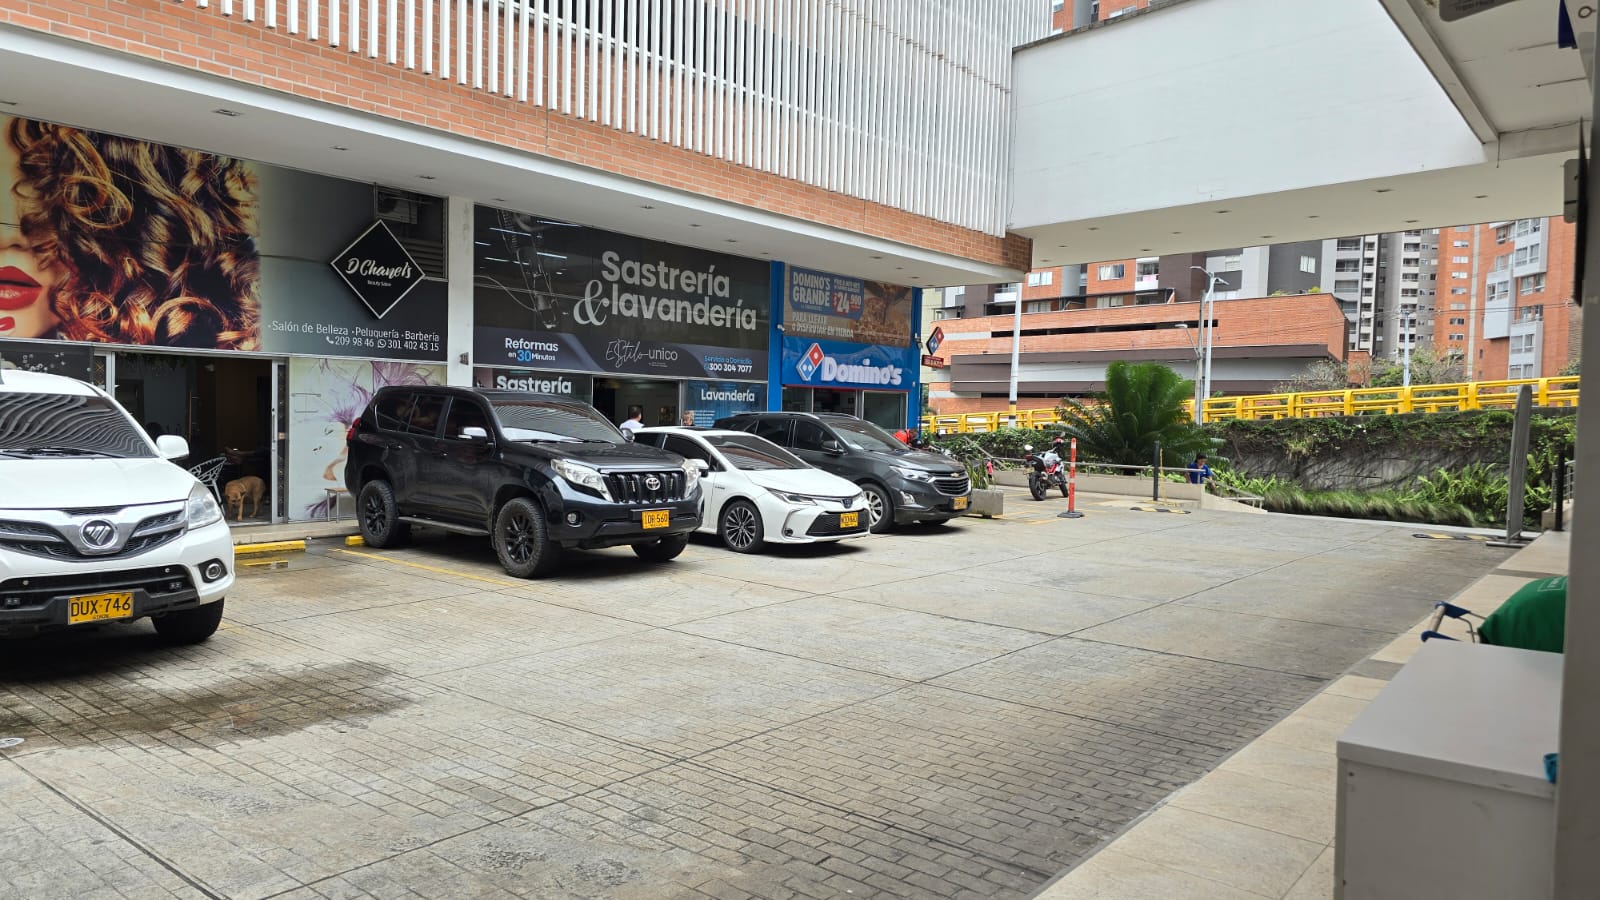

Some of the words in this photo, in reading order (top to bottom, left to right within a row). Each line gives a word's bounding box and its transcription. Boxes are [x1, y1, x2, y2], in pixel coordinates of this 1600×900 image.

[602, 250, 730, 298] Sastrería
[793, 272, 830, 290] DOMINO'S
[573, 279, 610, 326] &
[612, 284, 757, 330] lavandería
[792, 286, 830, 307] GRANDE
[272, 320, 298, 332] Salón
[302, 322, 314, 334] de
[316, 324, 348, 336] Belleza
[356, 326, 398, 340] Peluquería
[405, 330, 440, 342] Barbería
[334, 336, 350, 346] 209
[352, 338, 362, 346] 98
[364, 338, 374, 347] 46
[388, 340, 401, 349] 301
[404, 341, 417, 350] 402
[419, 342, 428, 351] 43
[430, 342, 439, 352] 15
[505, 338, 559, 352] Reformas
[517, 350, 532, 361] 30
[532, 353, 555, 361] Minutos
[709, 363, 722, 371] 300
[821, 357, 902, 386] Domino's
[496, 376, 572, 394] Sastrería
[701, 389, 755, 402] Lavandería
[71, 600, 98, 616] DUX
[104, 597, 131, 613] 746
